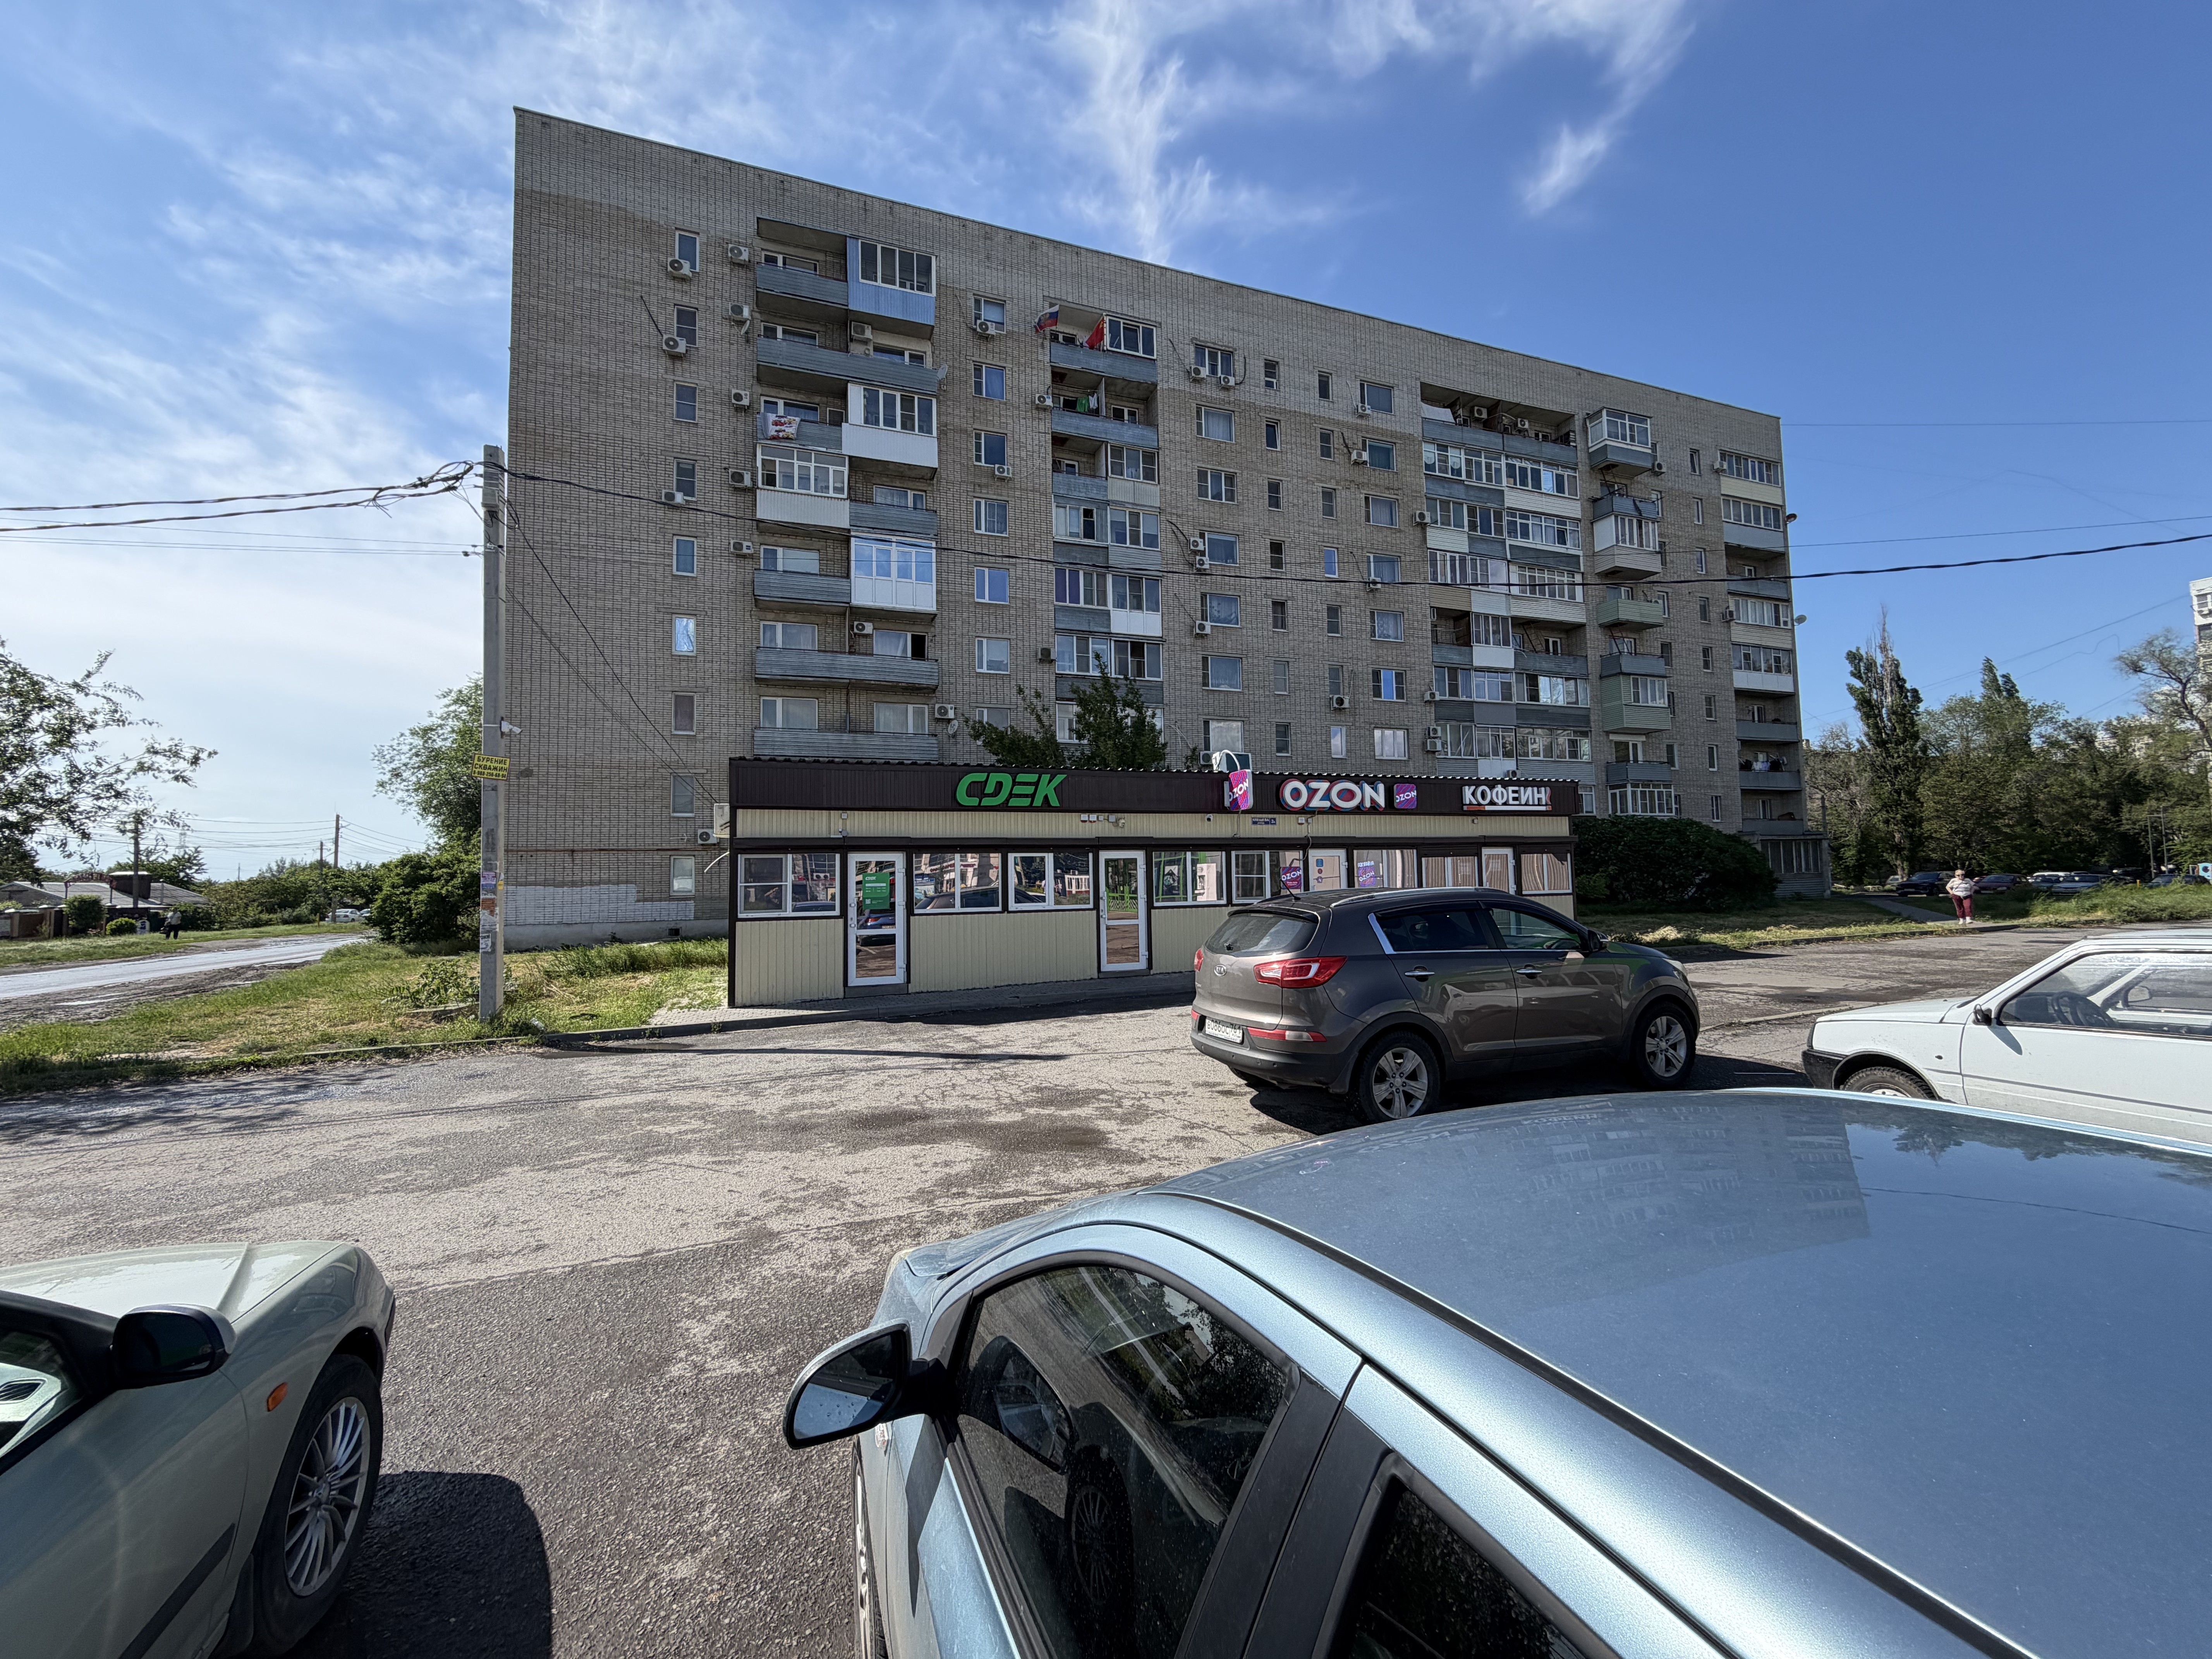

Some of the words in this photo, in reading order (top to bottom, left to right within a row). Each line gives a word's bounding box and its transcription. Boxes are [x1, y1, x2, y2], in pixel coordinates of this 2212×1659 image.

[477, 756, 507, 765] БУРЕНИЕ
[474, 763, 507, 773] СКВАЖИН
[957, 773, 1067, 806] CDEK
[1280, 779, 1385, 811] OZON
[1463, 785, 1546, 805] КОФЕИН
[1282, 870, 1302, 881] OZON
[1359, 871, 1375, 881] OZON
